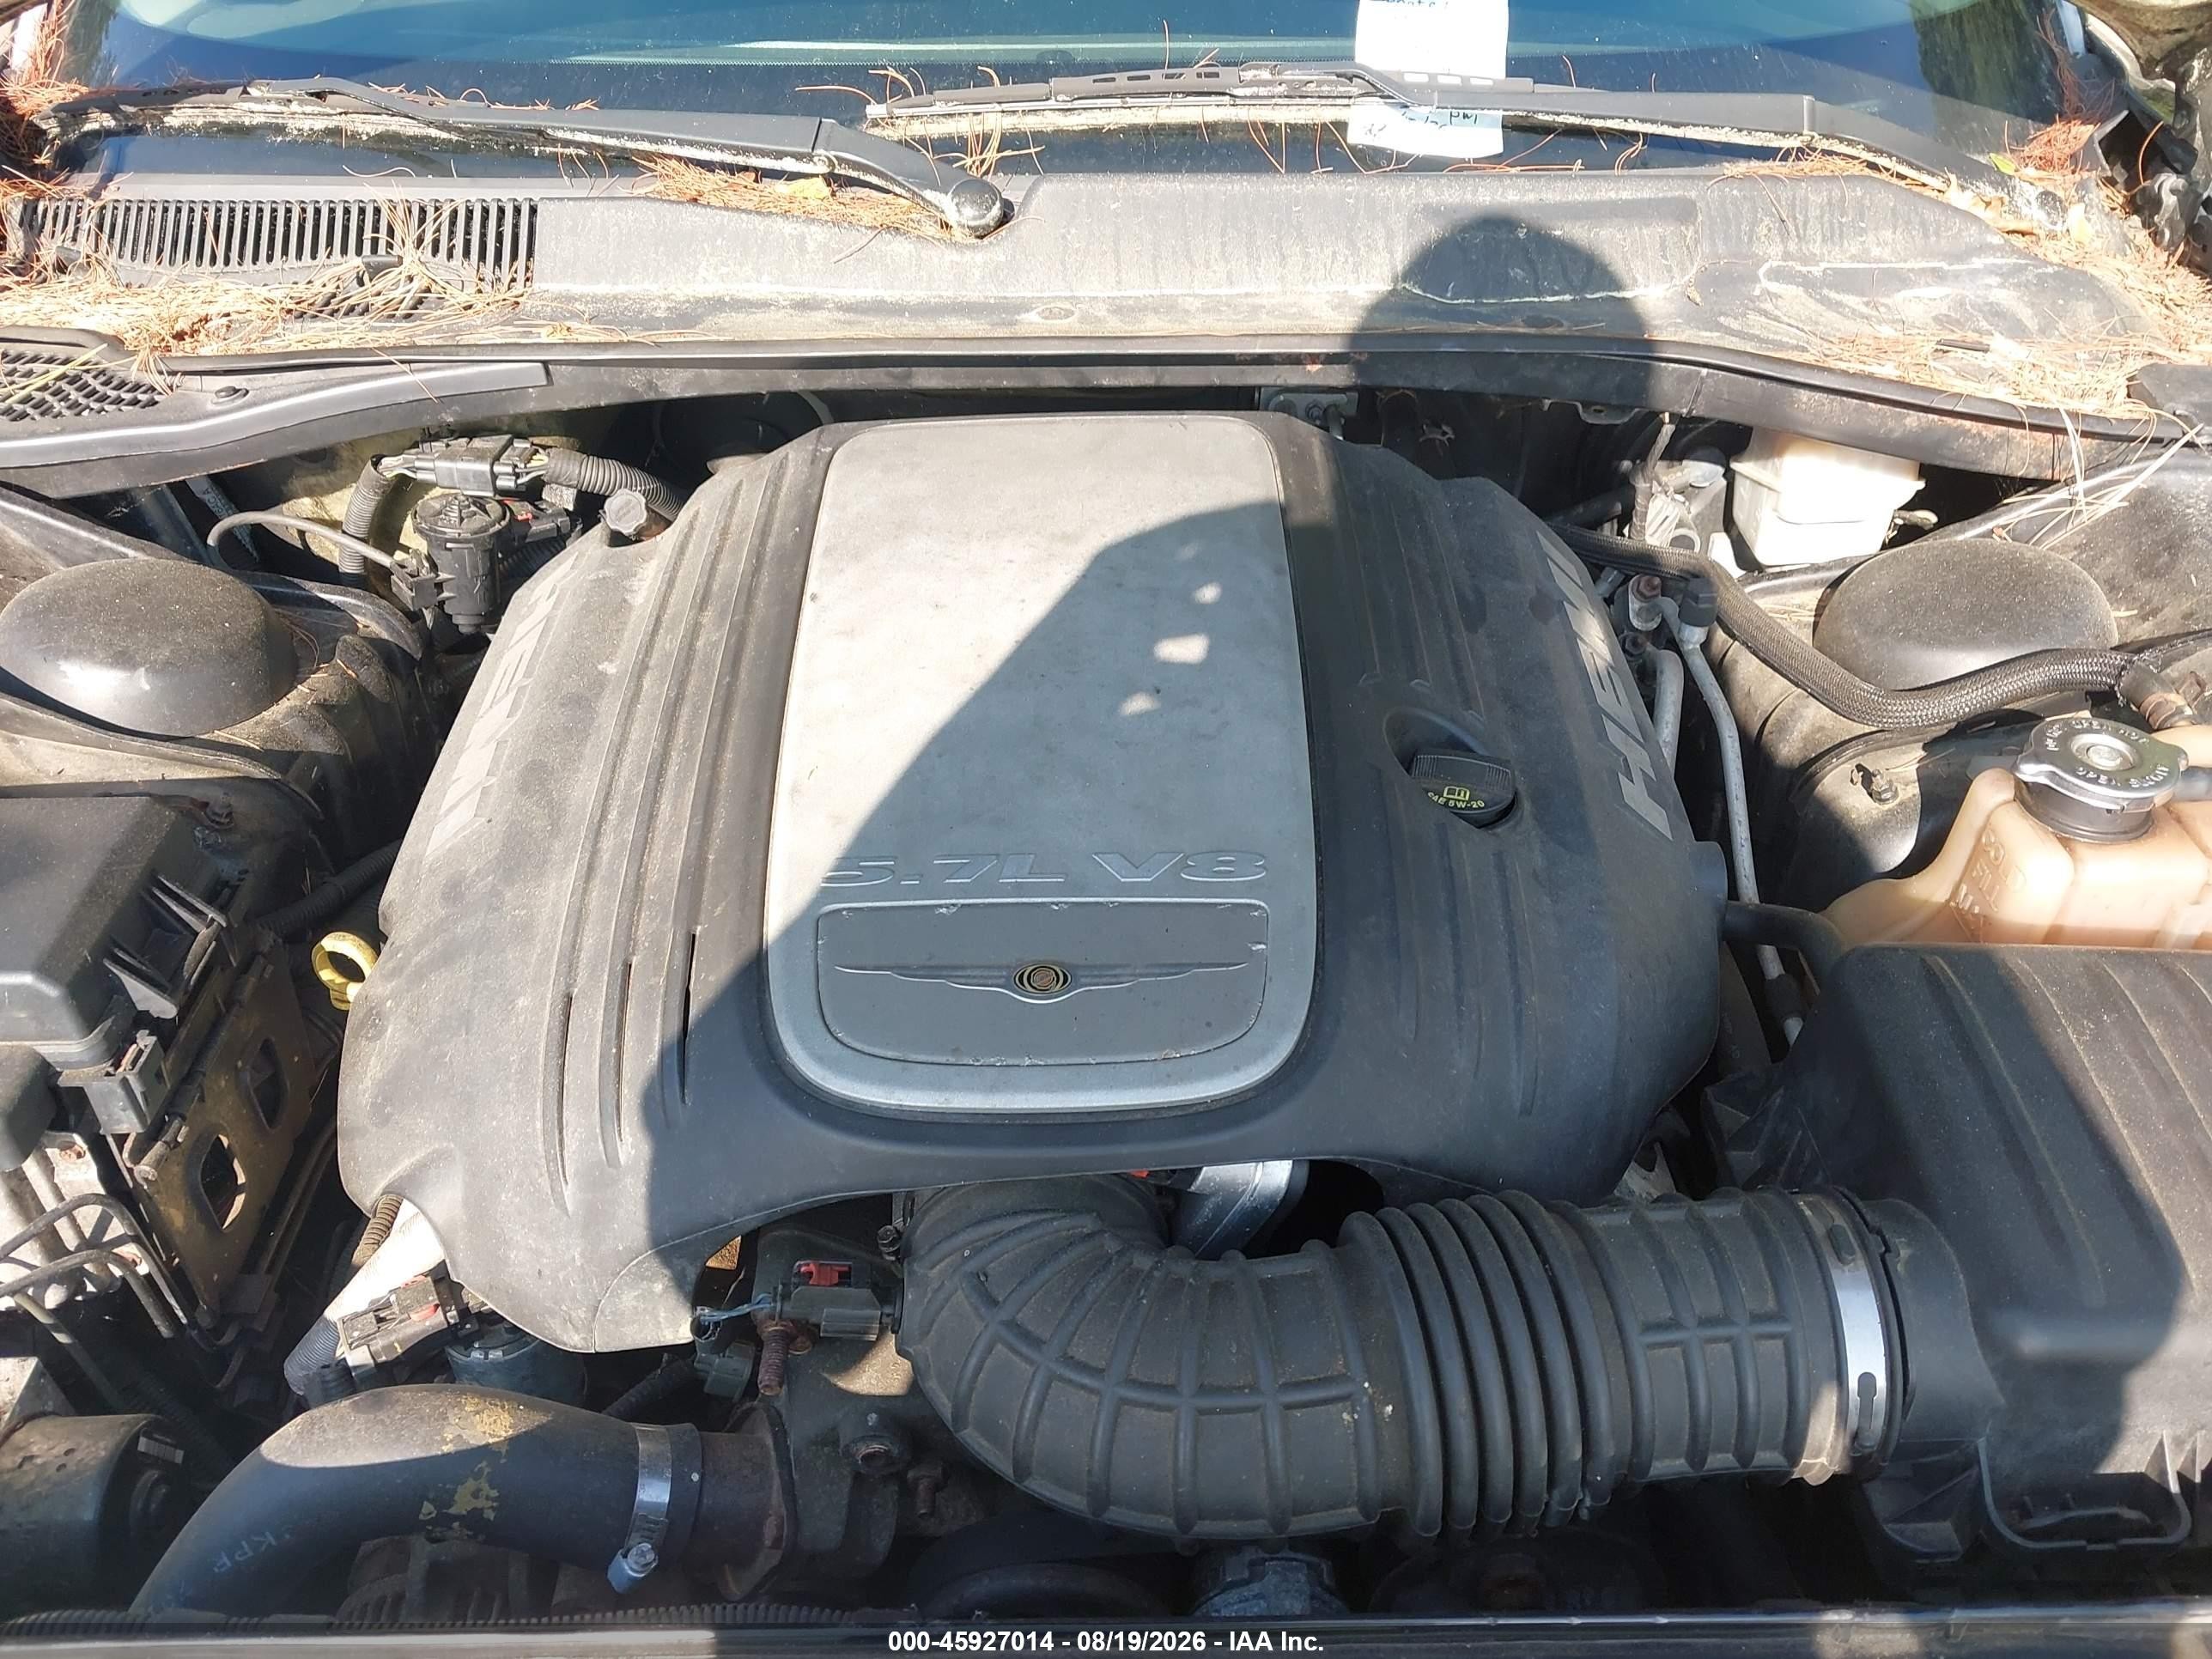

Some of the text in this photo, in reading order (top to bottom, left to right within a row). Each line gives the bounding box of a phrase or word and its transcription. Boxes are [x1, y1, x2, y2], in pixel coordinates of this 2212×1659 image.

[1536, 531, 1674, 842] HEMI
[1448, 799, 1485, 809] 5W-20
[820, 851, 1268, 888] 5.7L V8
